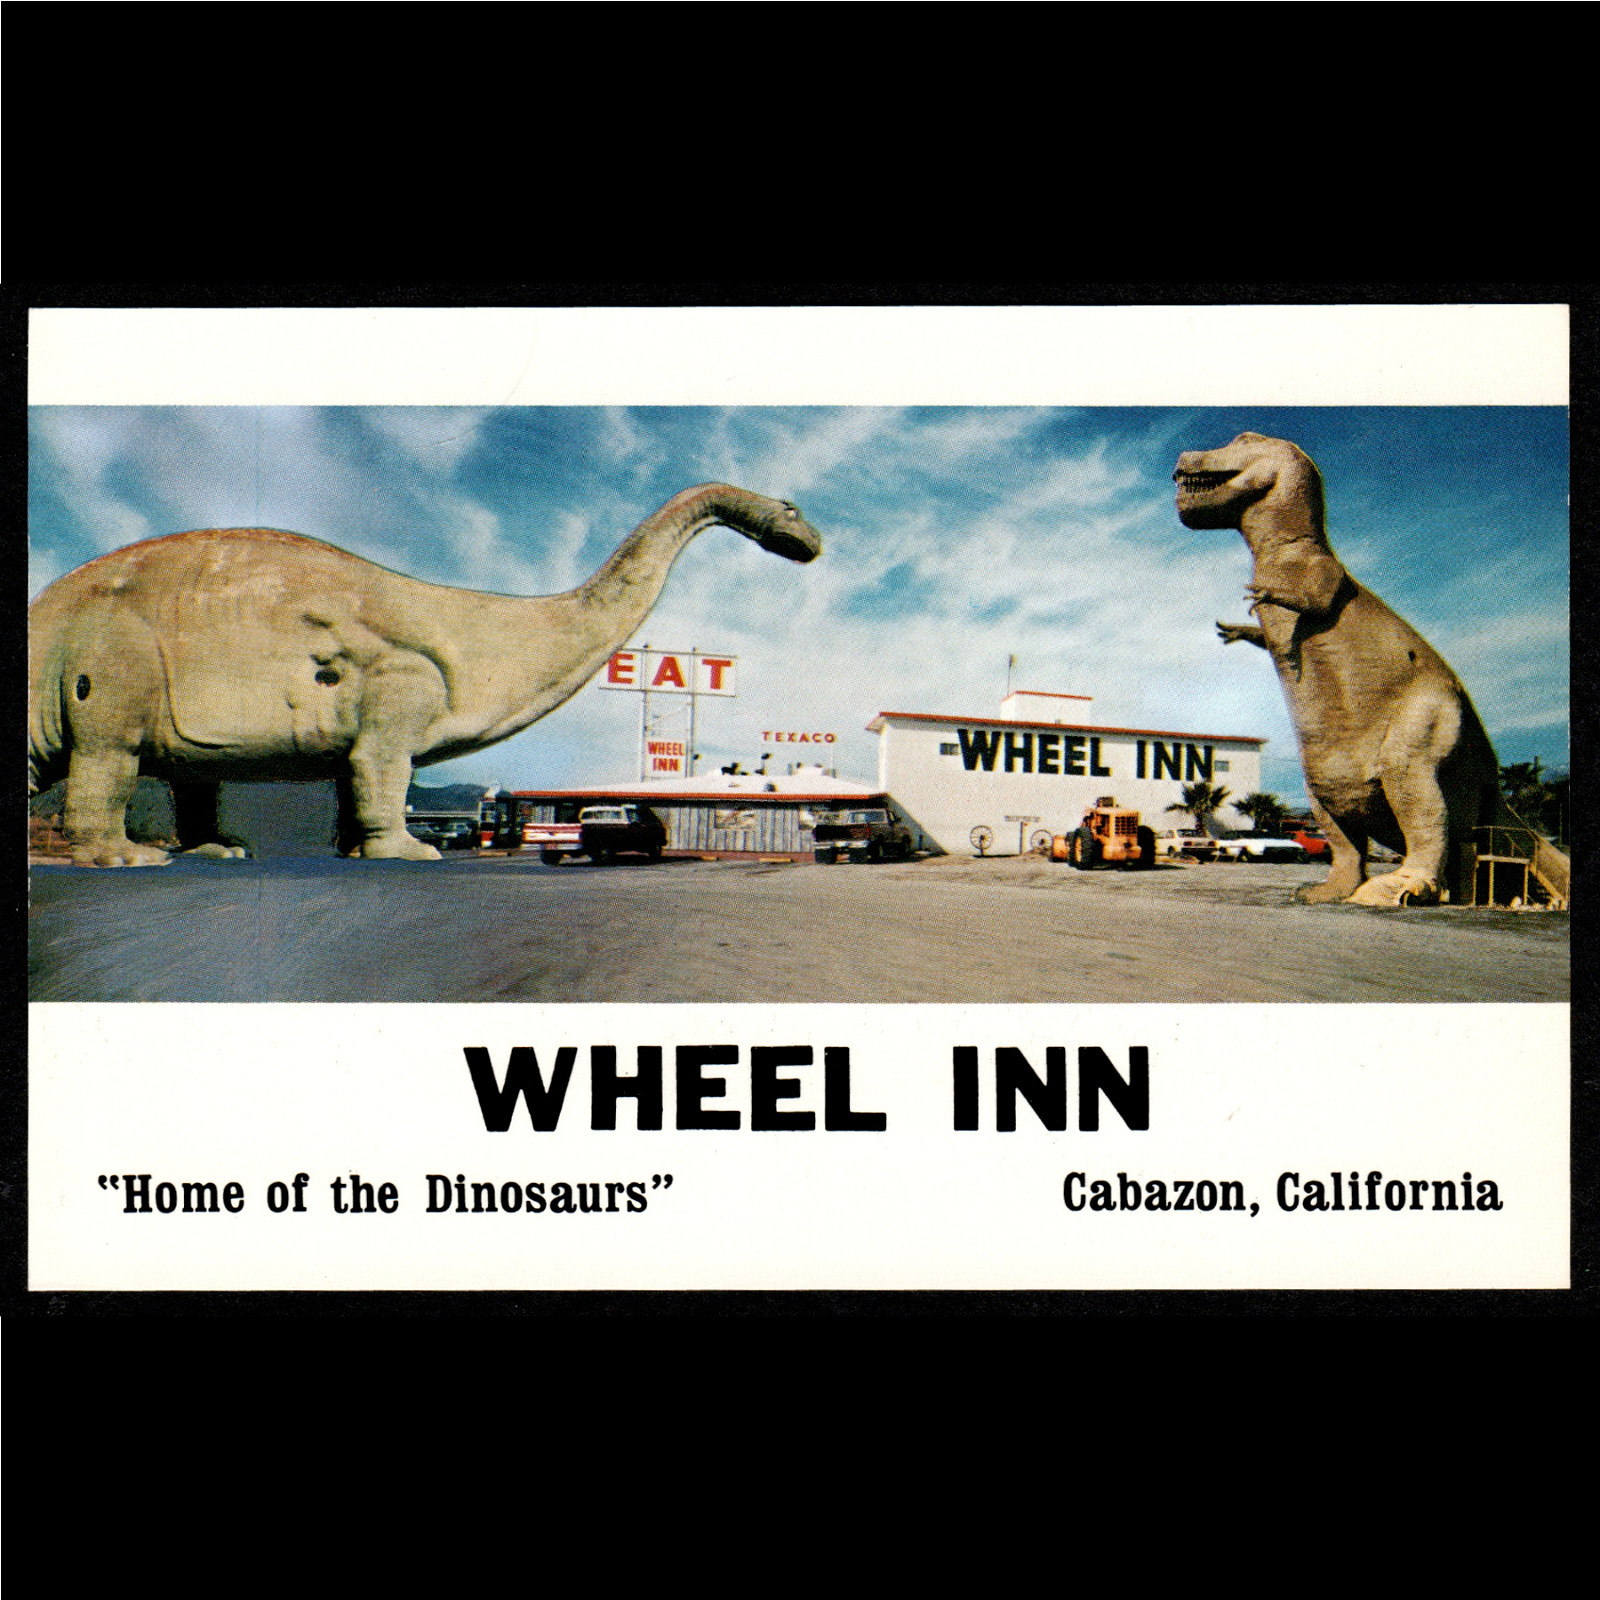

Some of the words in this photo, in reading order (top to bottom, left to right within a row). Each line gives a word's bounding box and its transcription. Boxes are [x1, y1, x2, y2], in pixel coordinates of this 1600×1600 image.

[606, 652, 733, 690] EAT
[647, 741, 685, 756] WHEEL
[762, 731, 836, 743] TEXACO
[957, 728, 1111, 777] WHEEL
[1136, 739, 1214, 782] INN
[652, 757, 680, 772] INN
[464, 1045, 886, 1132] WHEEL
[953, 1046, 1149, 1132] INN
[98, 1175, 244, 1213] “Home
[268, 1173, 309, 1212] of
[331, 1172, 398, 1213] the
[426, 1174, 673, 1213] Dinosaurs”
[1064, 1172, 1259, 1217] Cabazon,
[1277, 1171, 1503, 1211] California
